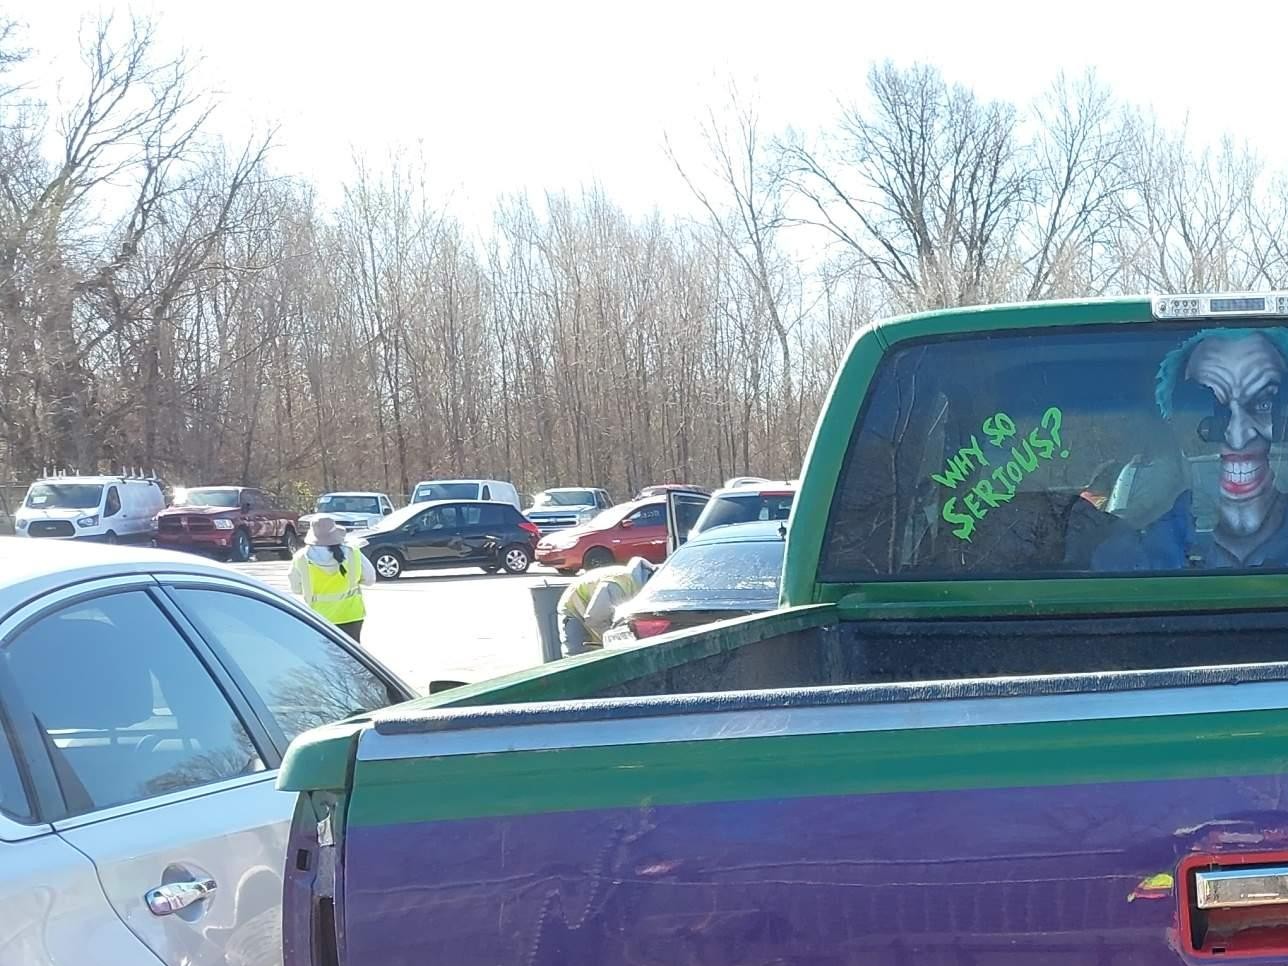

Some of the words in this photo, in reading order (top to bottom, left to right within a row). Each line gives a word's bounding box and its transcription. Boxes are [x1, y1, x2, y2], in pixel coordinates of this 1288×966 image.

[931, 435, 990, 488] WHY
[982, 413, 1016, 448] SO
[942, 407, 1069, 543] SERIOUS?
